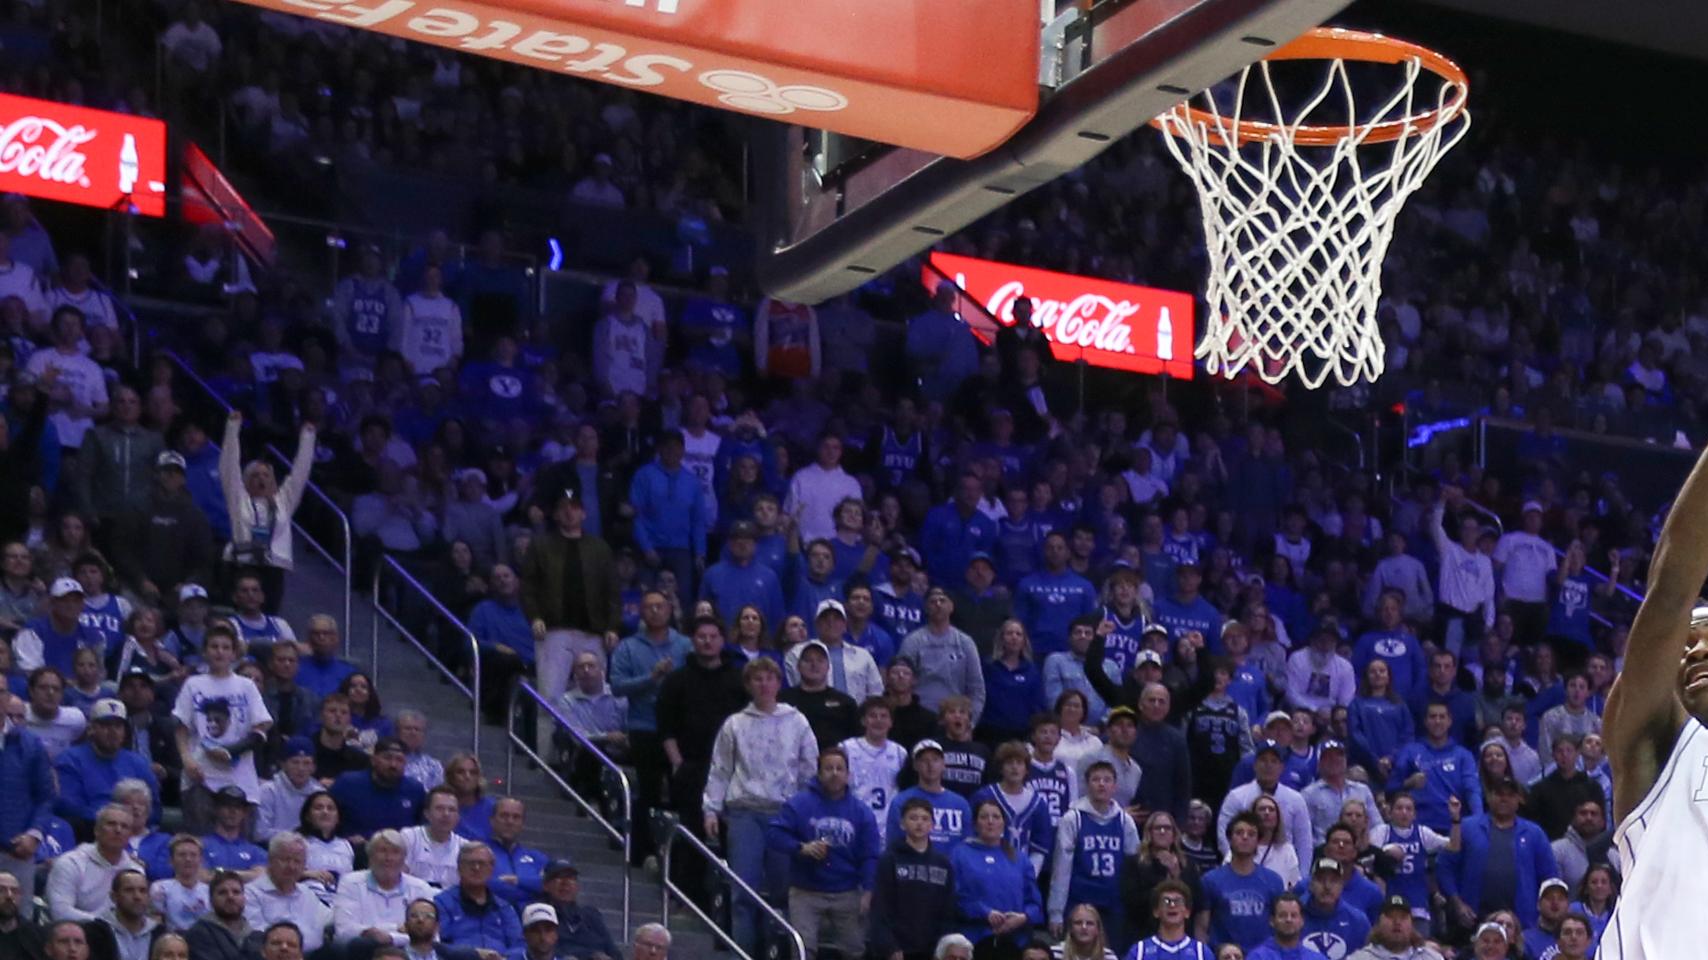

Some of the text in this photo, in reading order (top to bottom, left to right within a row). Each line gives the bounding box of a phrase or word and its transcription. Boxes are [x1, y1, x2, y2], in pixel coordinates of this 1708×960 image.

[406, 8, 693, 87] State
[987, 281, 1141, 354] Cca-Cola
[883, 602, 922, 622] BYU
[1104, 636, 1139, 655] BYU
[932, 807, 963, 832] YU
[1083, 836, 1120, 850] BYU
[1091, 853, 1115, 877] 13
